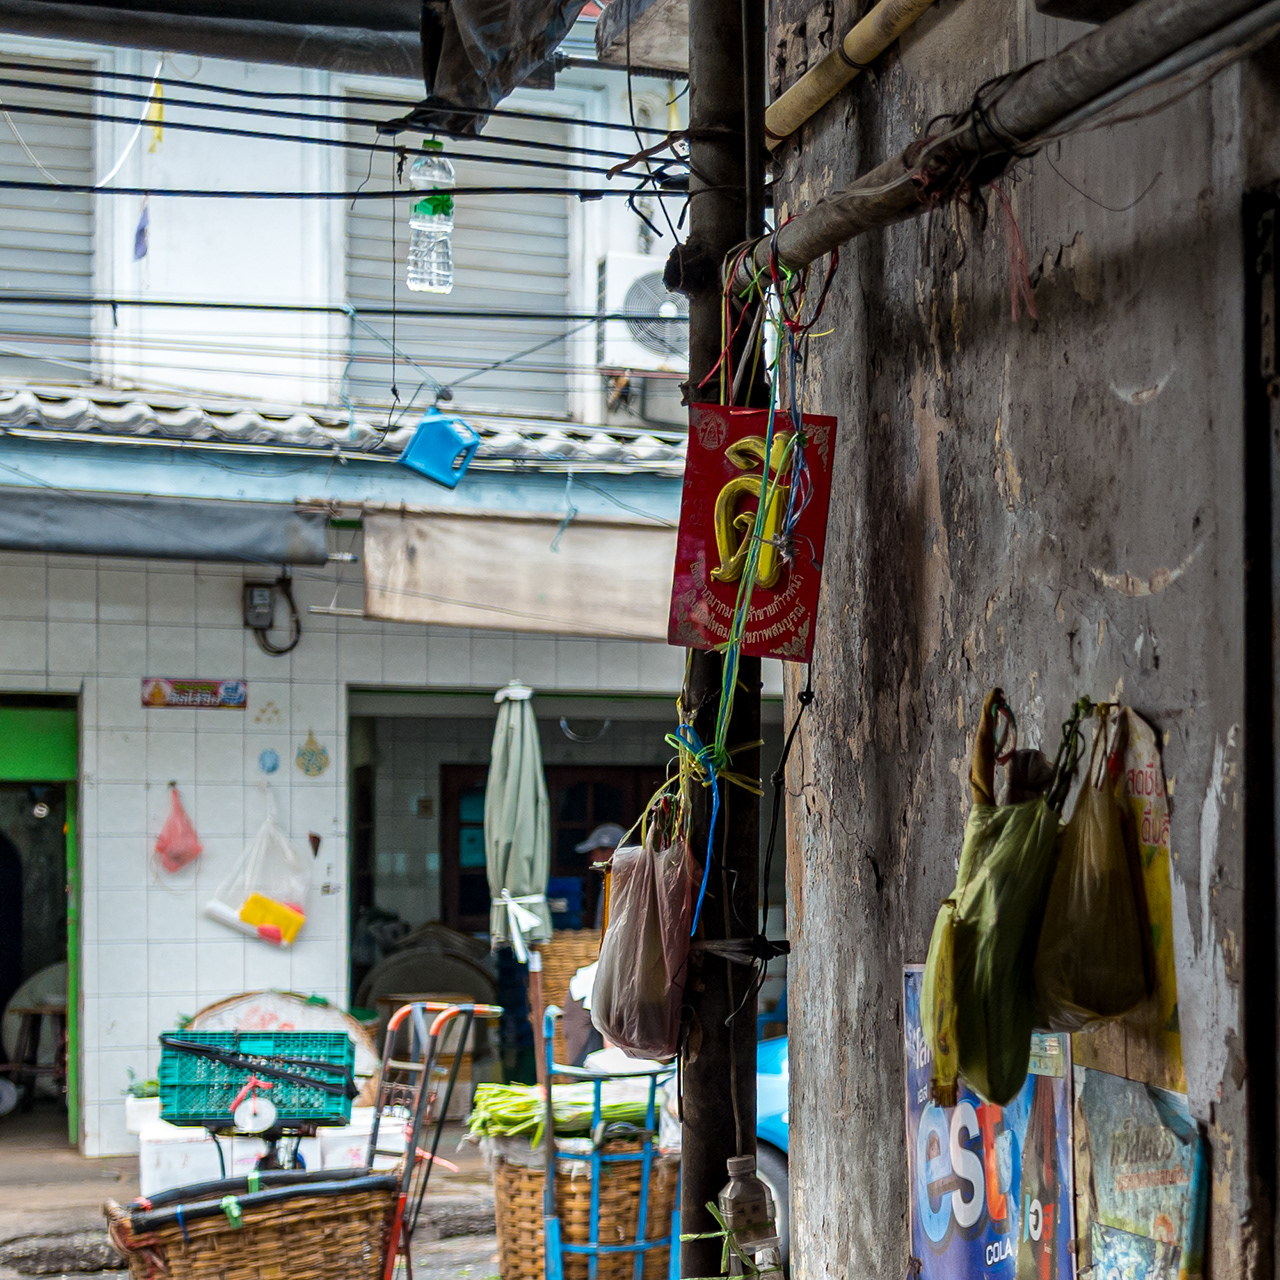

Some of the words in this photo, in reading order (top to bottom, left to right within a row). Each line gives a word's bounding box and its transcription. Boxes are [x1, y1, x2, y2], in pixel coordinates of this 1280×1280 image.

[747, 574, 805, 622] ค้าขายก้าวหน้า
[917, 1101, 1007, 1243] est
[986, 1238, 1013, 1266] COLA
